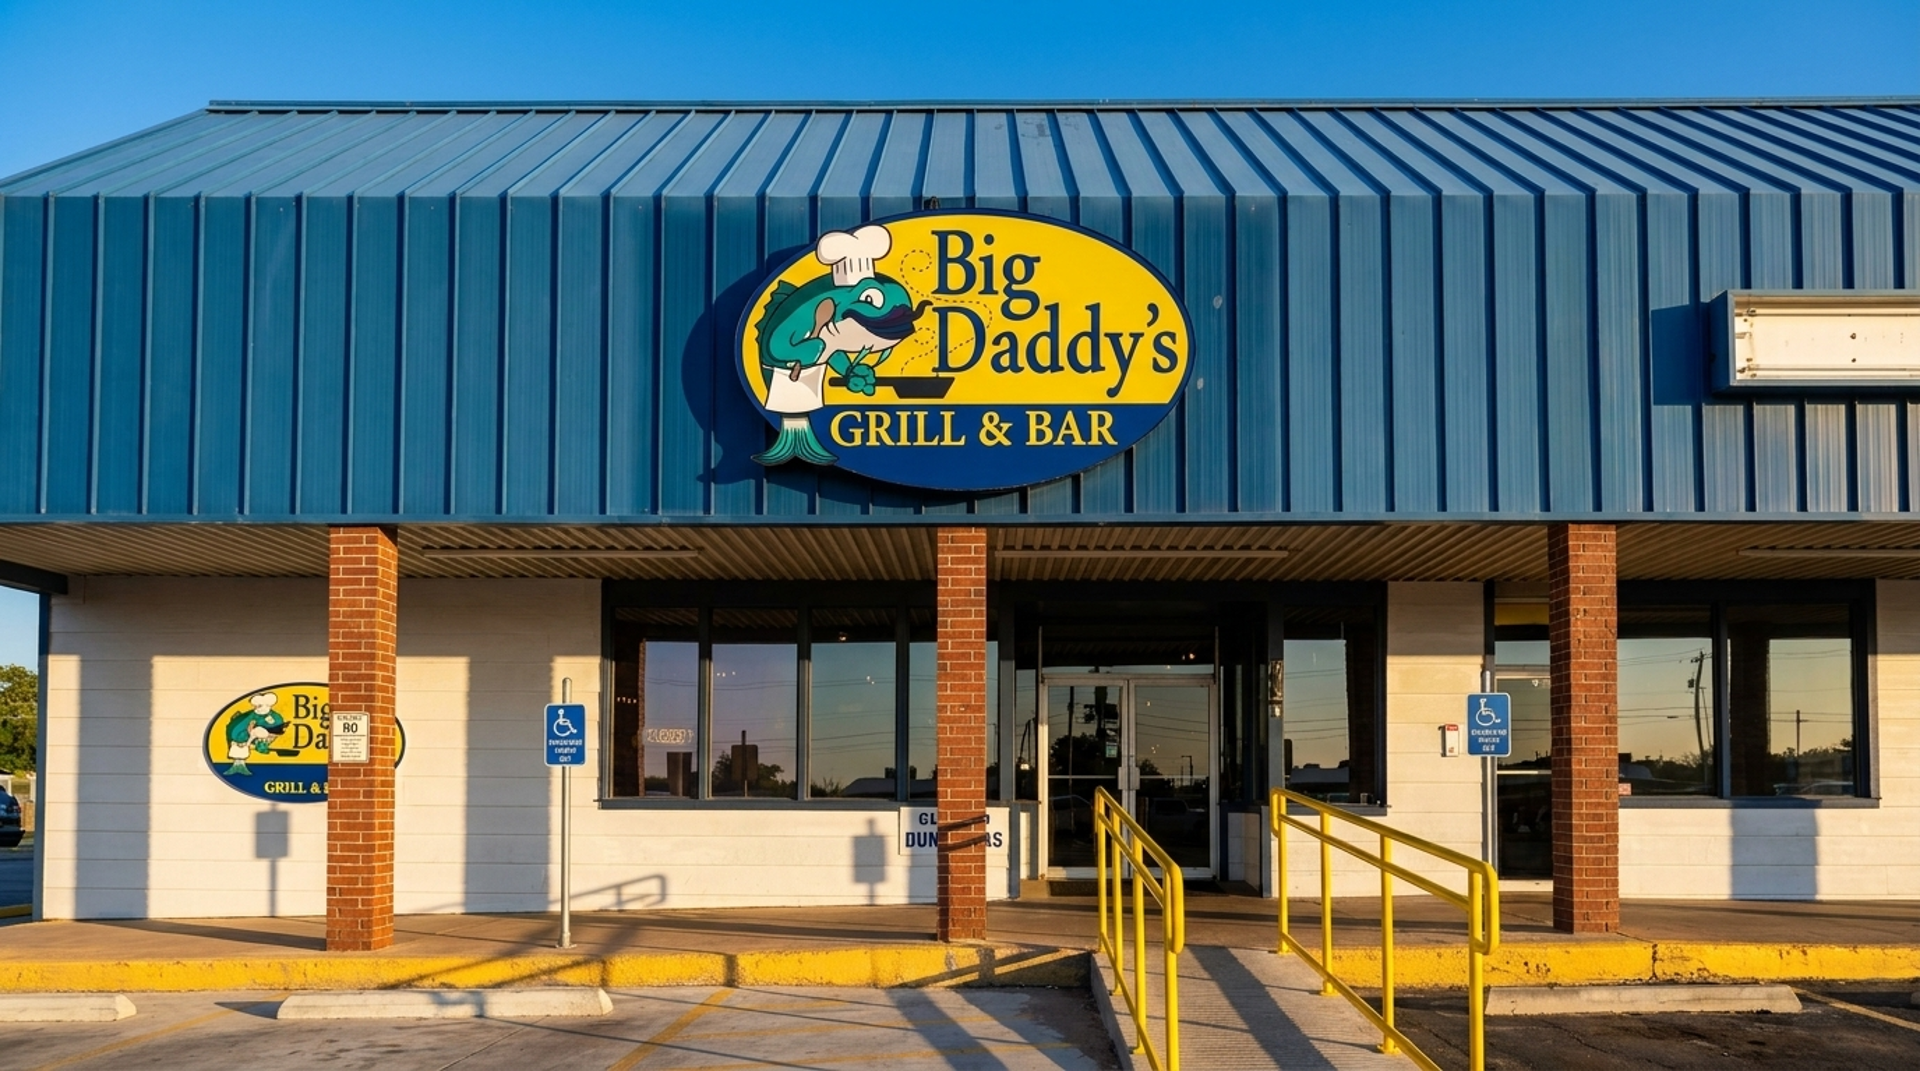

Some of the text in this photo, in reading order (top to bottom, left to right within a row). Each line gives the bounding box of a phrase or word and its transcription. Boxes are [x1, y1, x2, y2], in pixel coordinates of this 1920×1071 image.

[931, 229, 1041, 321] Big
[931, 303, 1178, 398] Daddy's
[829, 410, 1118, 447] GRILL & BAR
[264, 781, 307, 795] GRILL
